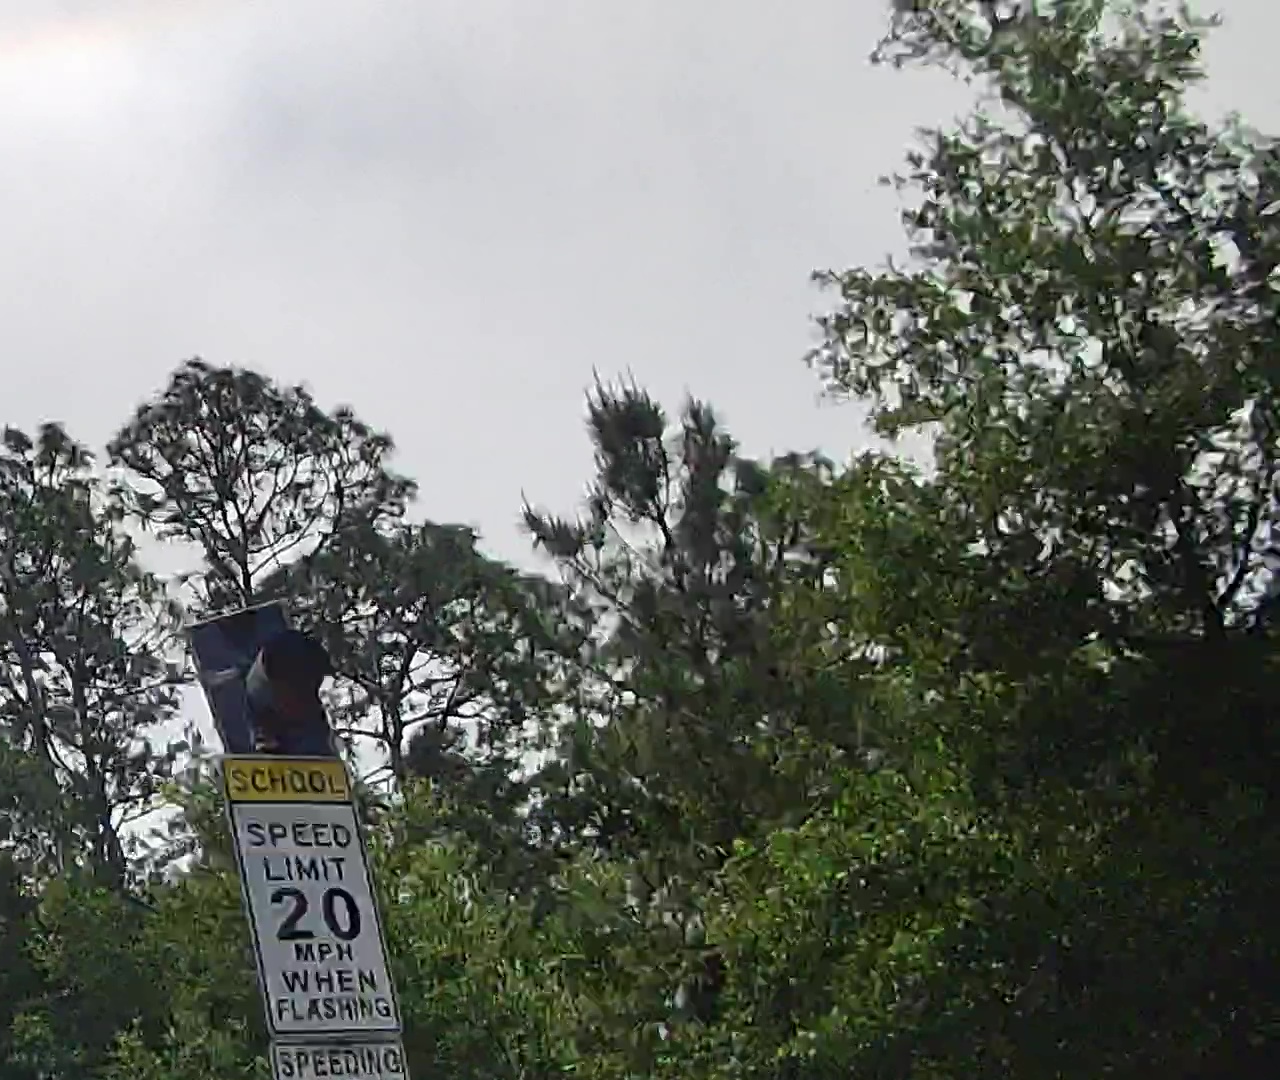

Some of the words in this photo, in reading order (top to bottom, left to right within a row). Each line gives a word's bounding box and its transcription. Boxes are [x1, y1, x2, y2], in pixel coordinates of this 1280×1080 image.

[230, 768, 346, 796] SCHOOL
[247, 823, 351, 848] SPEED
[263, 856, 346, 881] LIMIT
[270, 887, 361, 941] 20
[295, 943, 354, 962] MPH
[282, 969, 377, 994] WHEN
[277, 999, 392, 1023] FLASHING
[280, 1047, 402, 1077] SPEEDING
